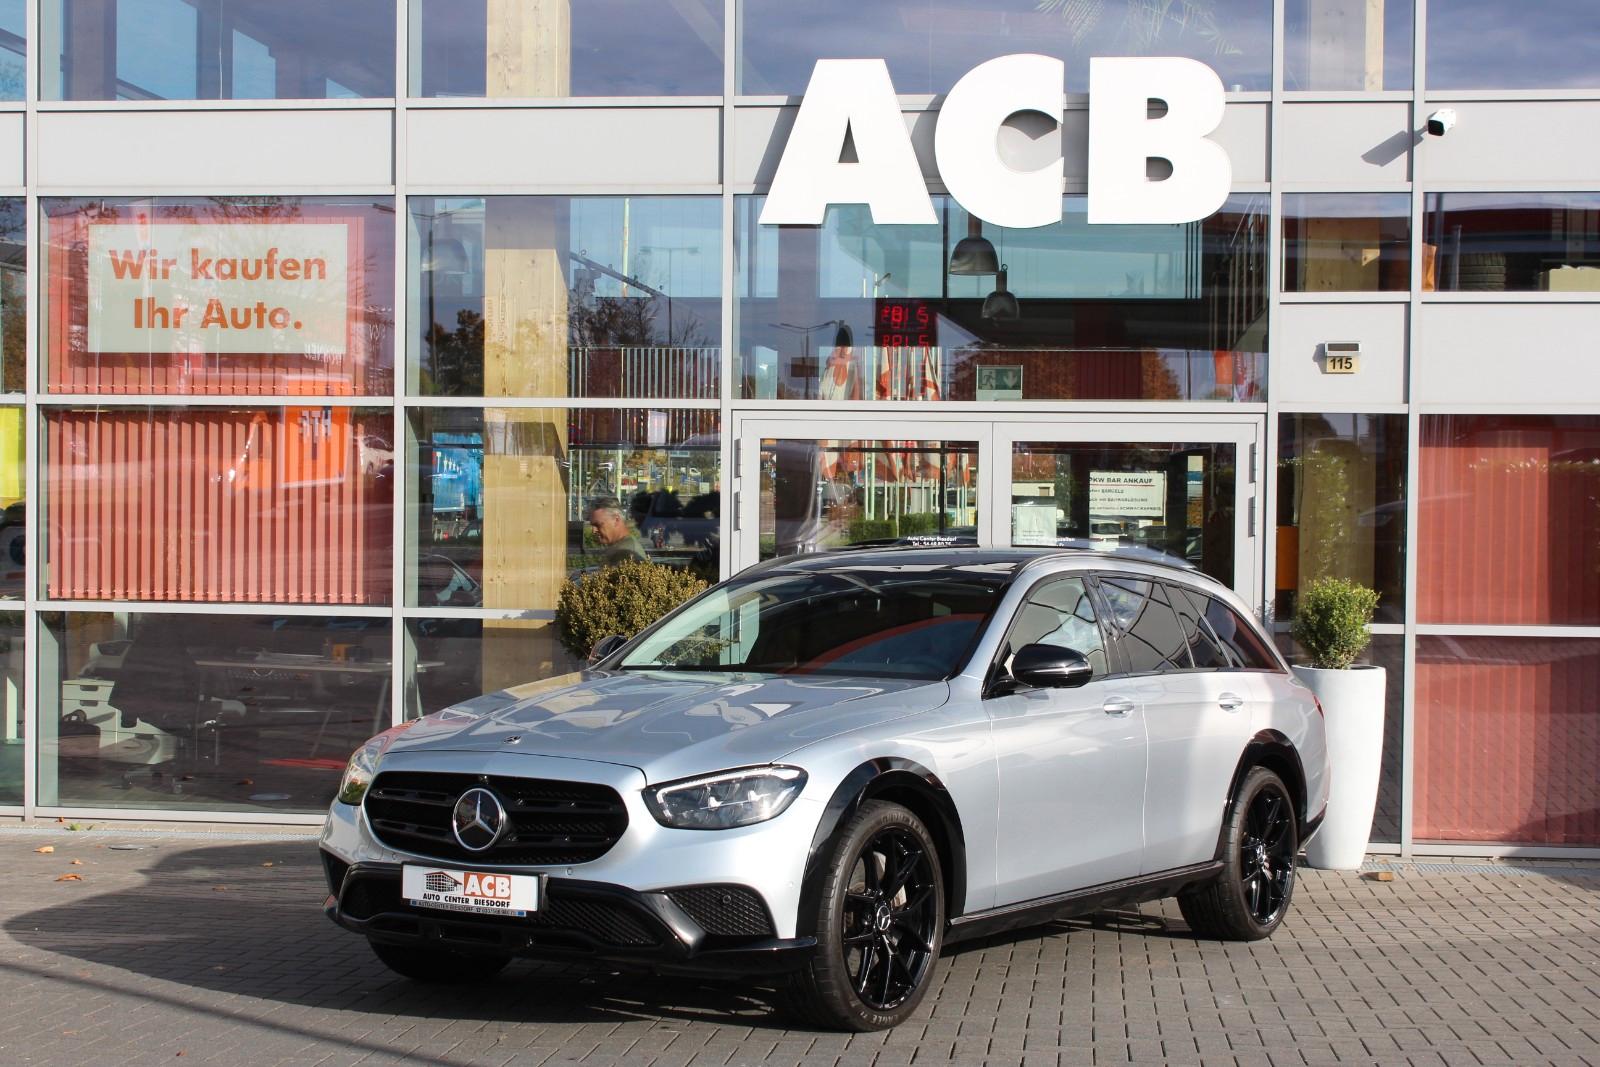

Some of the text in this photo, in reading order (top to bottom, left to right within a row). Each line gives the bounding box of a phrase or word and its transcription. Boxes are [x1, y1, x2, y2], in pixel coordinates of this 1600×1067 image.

[758, 53, 1233, 229] ACB
[108, 248, 326, 281] Wir kaufen
[133, 297, 303, 330] Ihr Auto.
[1329, 357, 1353, 370] 115
[464, 874, 511, 898] ACB
[422, 893, 511, 908] AUTO CENTER BIESDORF
